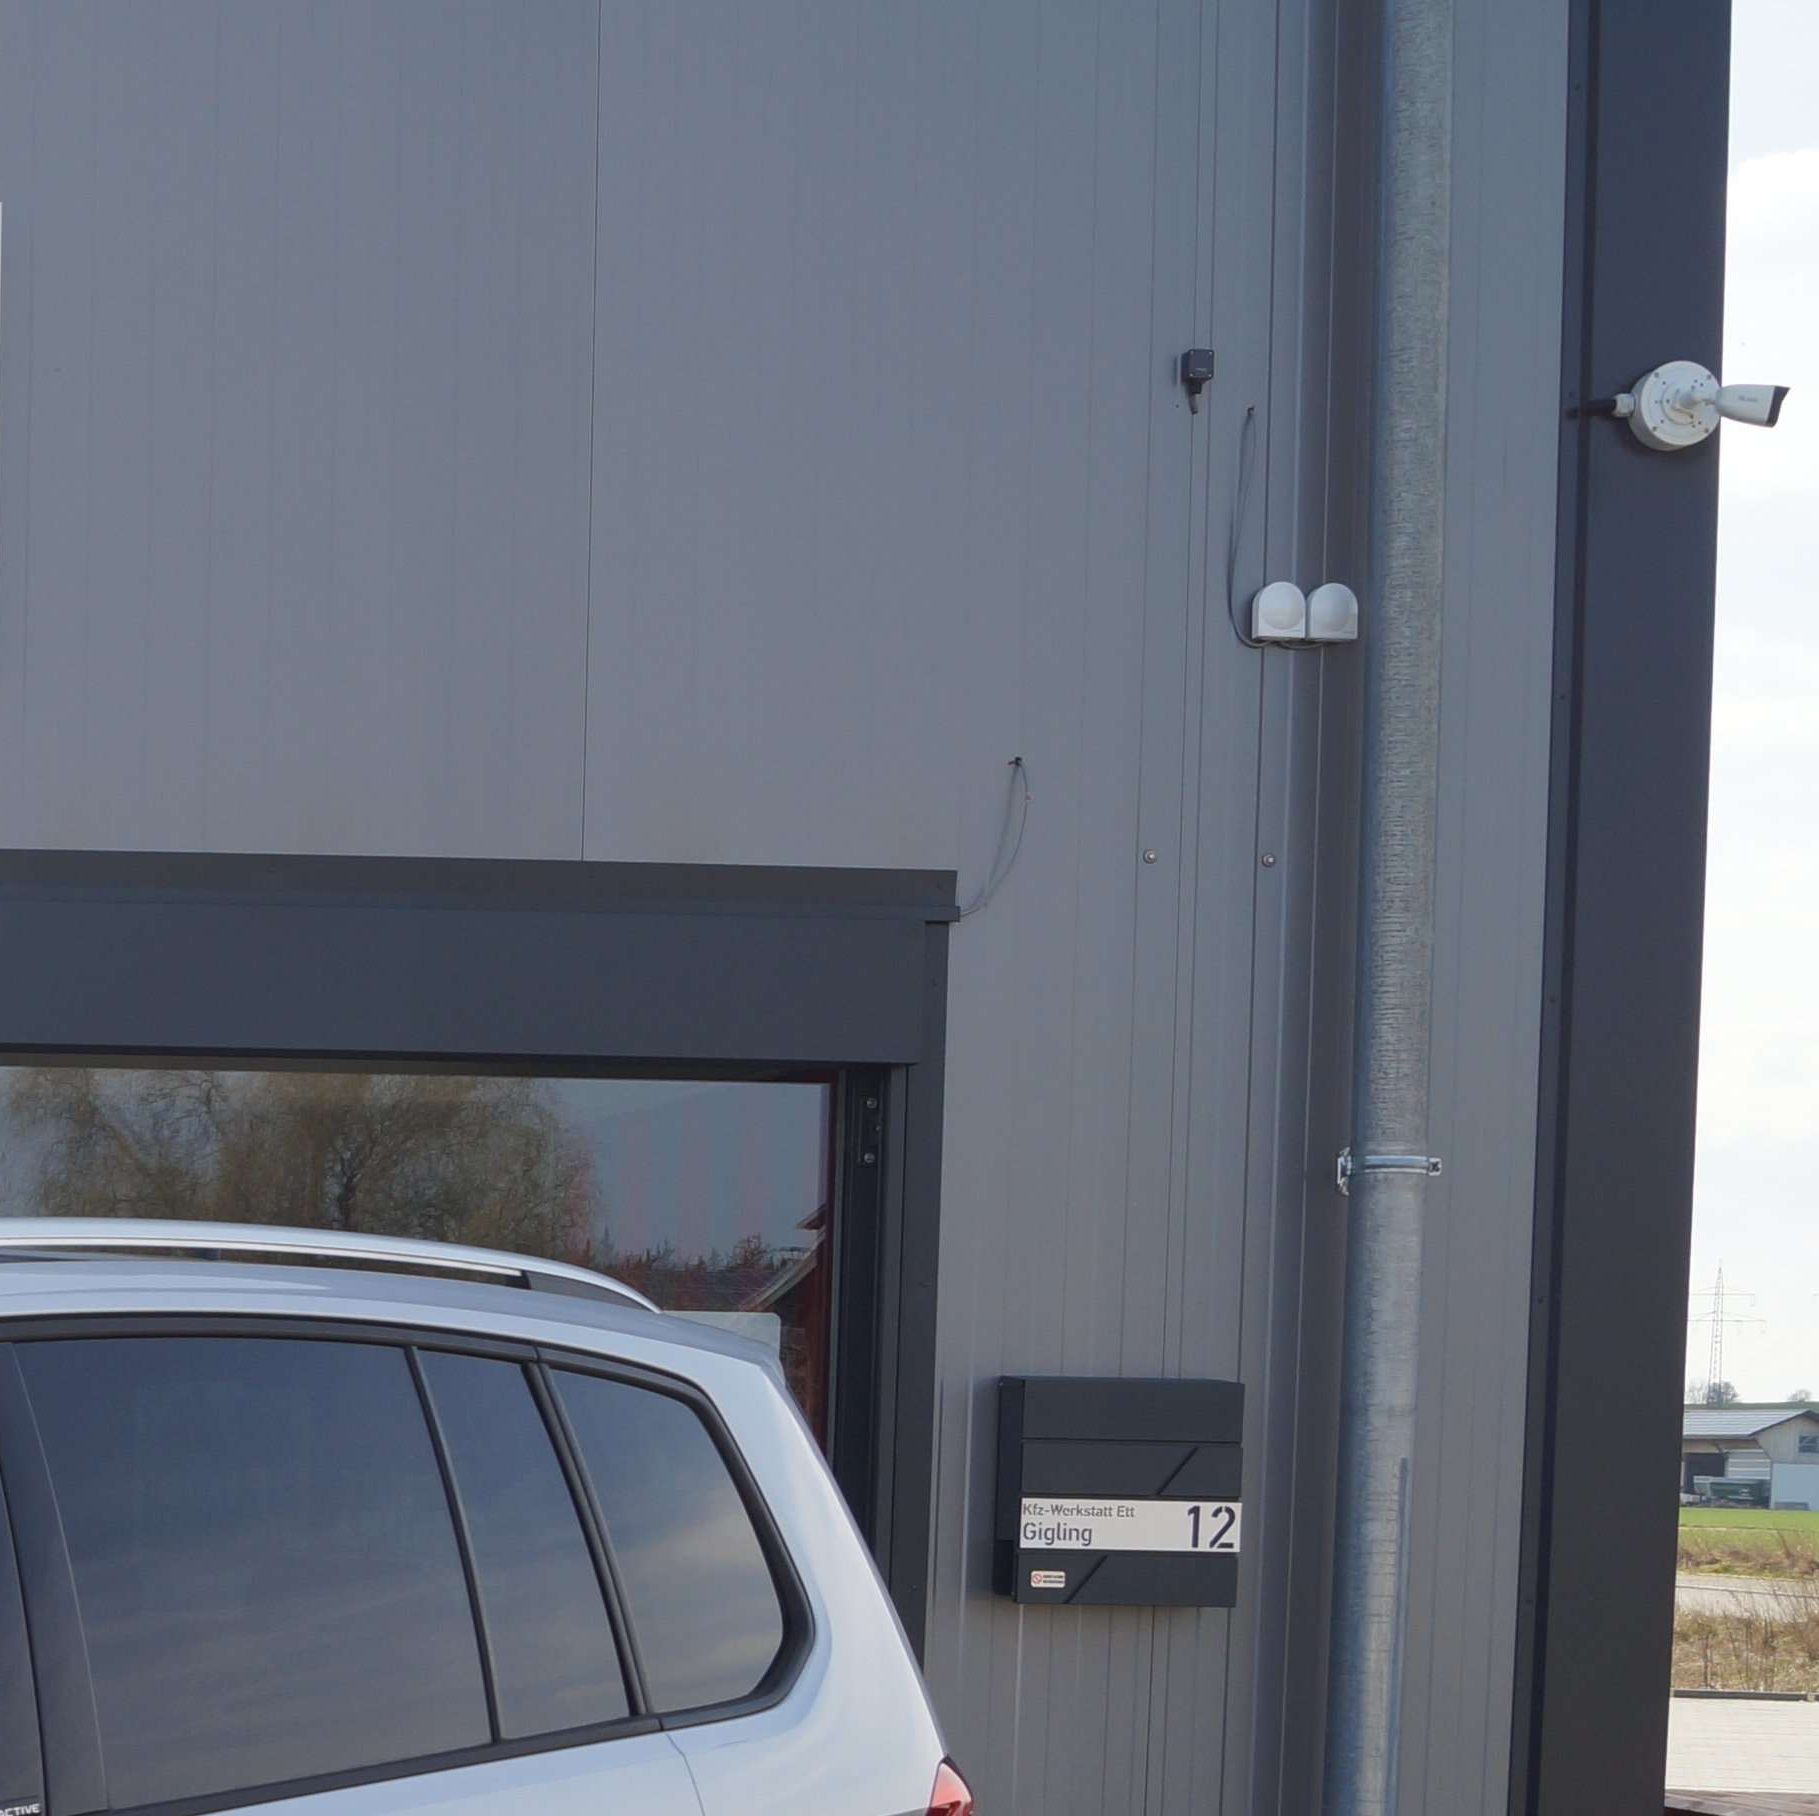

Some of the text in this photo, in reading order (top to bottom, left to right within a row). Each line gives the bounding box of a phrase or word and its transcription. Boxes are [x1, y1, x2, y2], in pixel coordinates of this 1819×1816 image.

[1023, 1503, 1135, 1518] Kfz-Werkstatt Ett
[1023, 1522, 1093, 1546] Gigling
[1187, 1505, 1236, 1549] 12
